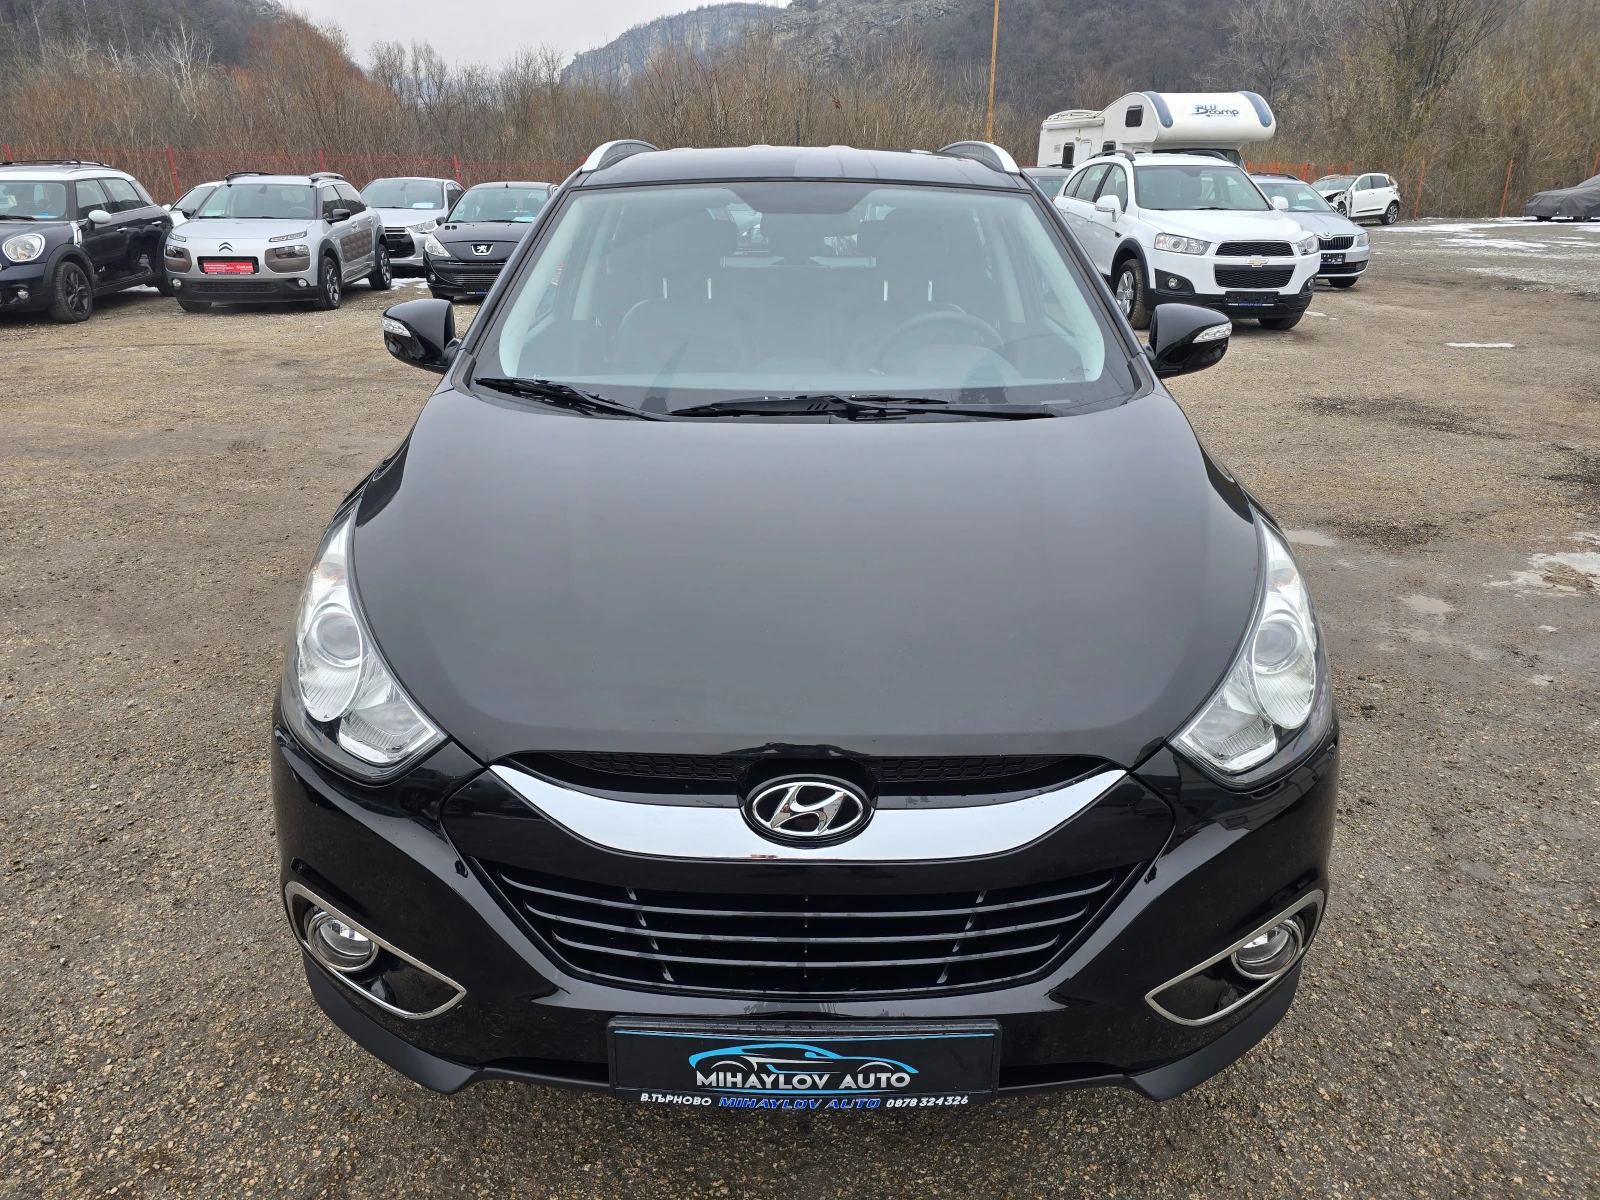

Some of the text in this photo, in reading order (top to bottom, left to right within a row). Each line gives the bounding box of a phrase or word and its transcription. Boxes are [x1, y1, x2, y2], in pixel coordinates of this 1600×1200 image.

[696, 1070, 911, 1090] MIHAYLOV AUTO
[718, 1097, 818, 1110] MIHAYLOV
[825, 1097, 881, 1109] AUTO
[886, 1098, 918, 1108] 0878
